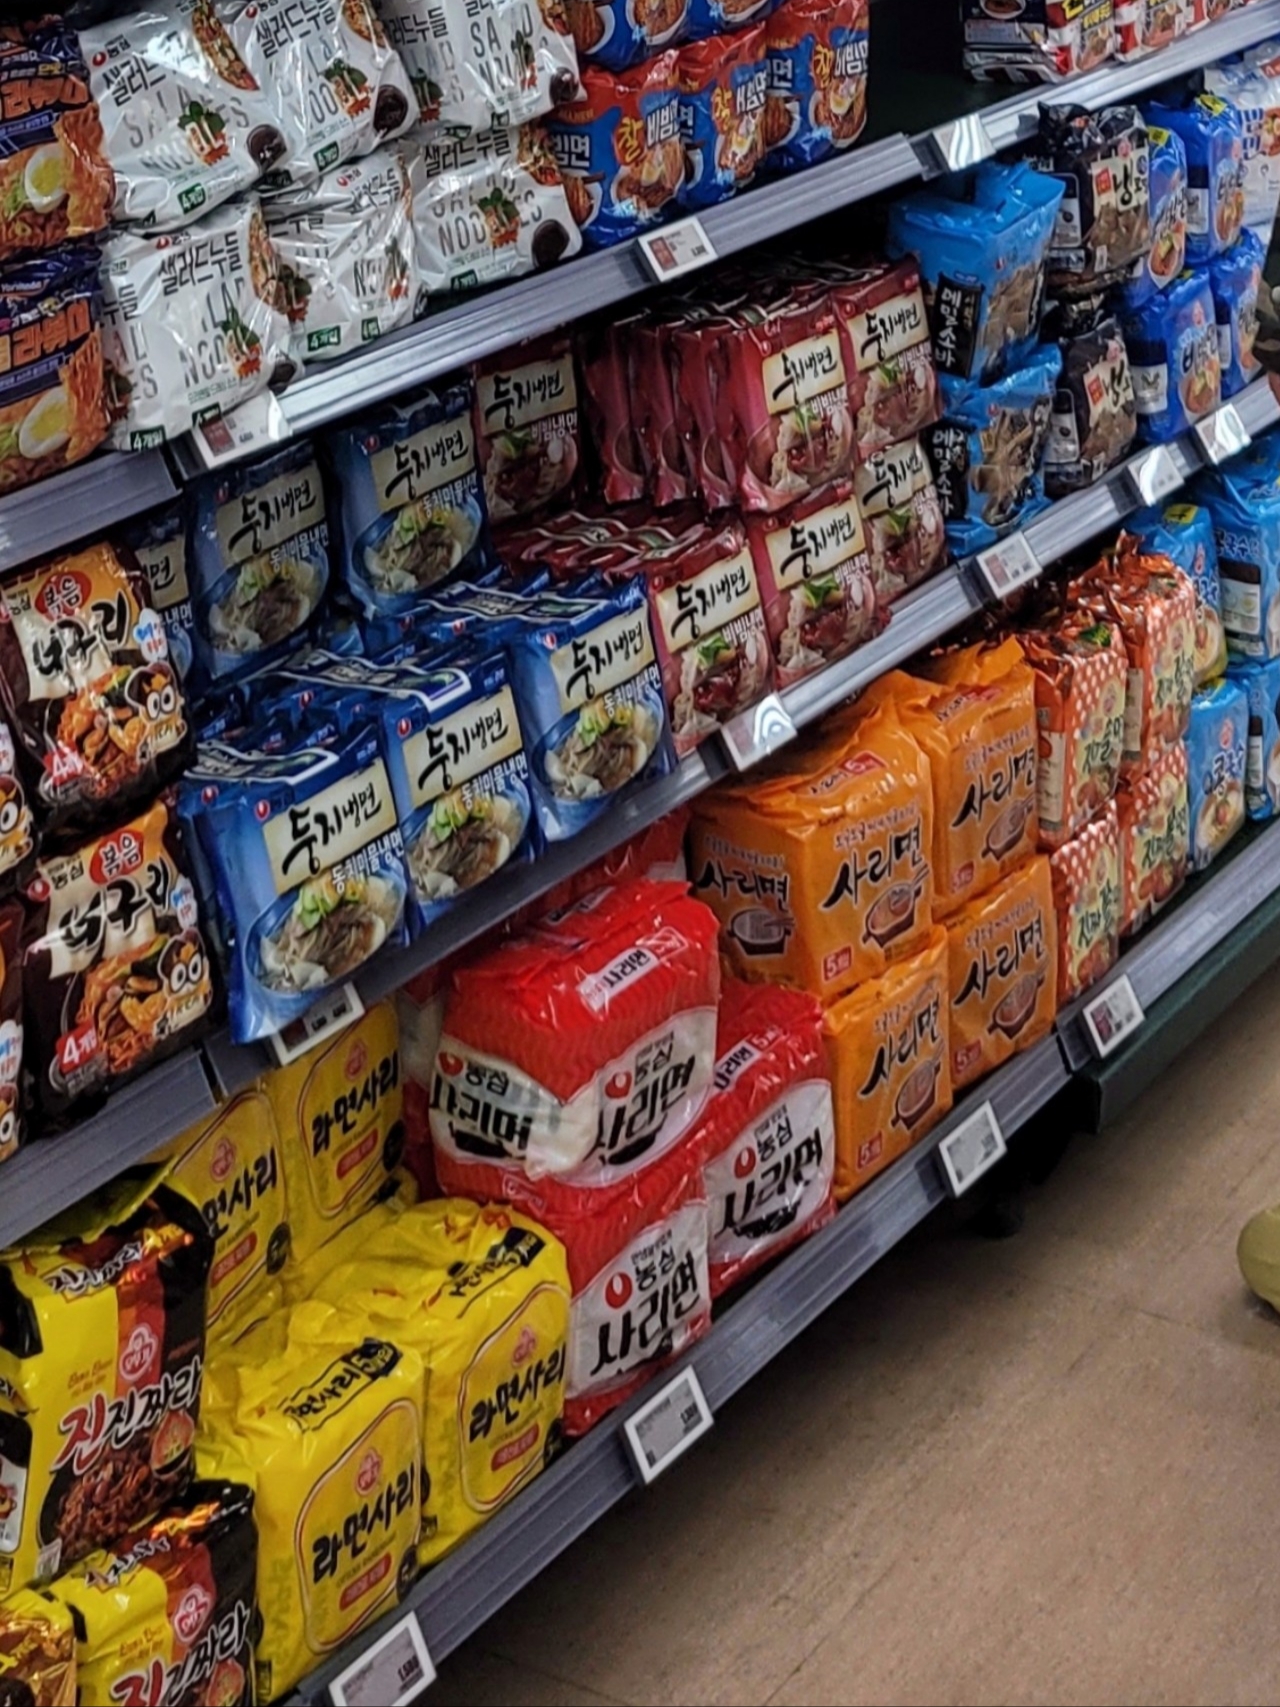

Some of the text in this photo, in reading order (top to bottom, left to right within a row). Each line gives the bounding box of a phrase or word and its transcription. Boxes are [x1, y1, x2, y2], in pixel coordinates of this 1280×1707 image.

[158, 230, 242, 297] 샐러드누들
[861, 300, 923, 363] 둥지냉면
[934, 285, 962, 369] 메밀소바
[485, 370, 564, 429] 둥지냉면
[385, 430, 470, 500] 둥지냉면
[230, 479, 318, 552] 둥지냉면
[781, 513, 856, 581] 둥지냉면
[41, 575, 81, 610] 볶음
[670, 564, 751, 641] 둥지냉면
[33, 591, 128, 678] 너구리
[565, 620, 645, 700] 둥지냉면
[417, 710, 509, 792] 둥지냉면
[951, 745, 1036, 828] 사리면
[50, 834, 141, 891] 농심 볶음
[280, 782, 384, 876] 둥지냉면
[822, 815, 922, 910] 사리면
[60, 862, 173, 954] 너구리
[697, 860, 790, 913] 사리면
[953, 908, 1045, 1006] 사리면
[465, 1060, 509, 1095] 농심
[633, 1050, 673, 1082] 농심
[859, 991, 939, 1096] 사리면
[311, 1052, 398, 1152] 라면사리
[713, 1129, 822, 1241] 사리면
[755, 1127, 794, 1163] 농심
[202, 1149, 277, 1237] 면사리
[589, 1251, 697, 1378] 사리면
[634, 1259, 676, 1292] 농심
[51, 1355, 203, 1476] 진진짜라
[469, 1343, 566, 1443] 라면사리
[311, 1458, 415, 1584] 라면사리
